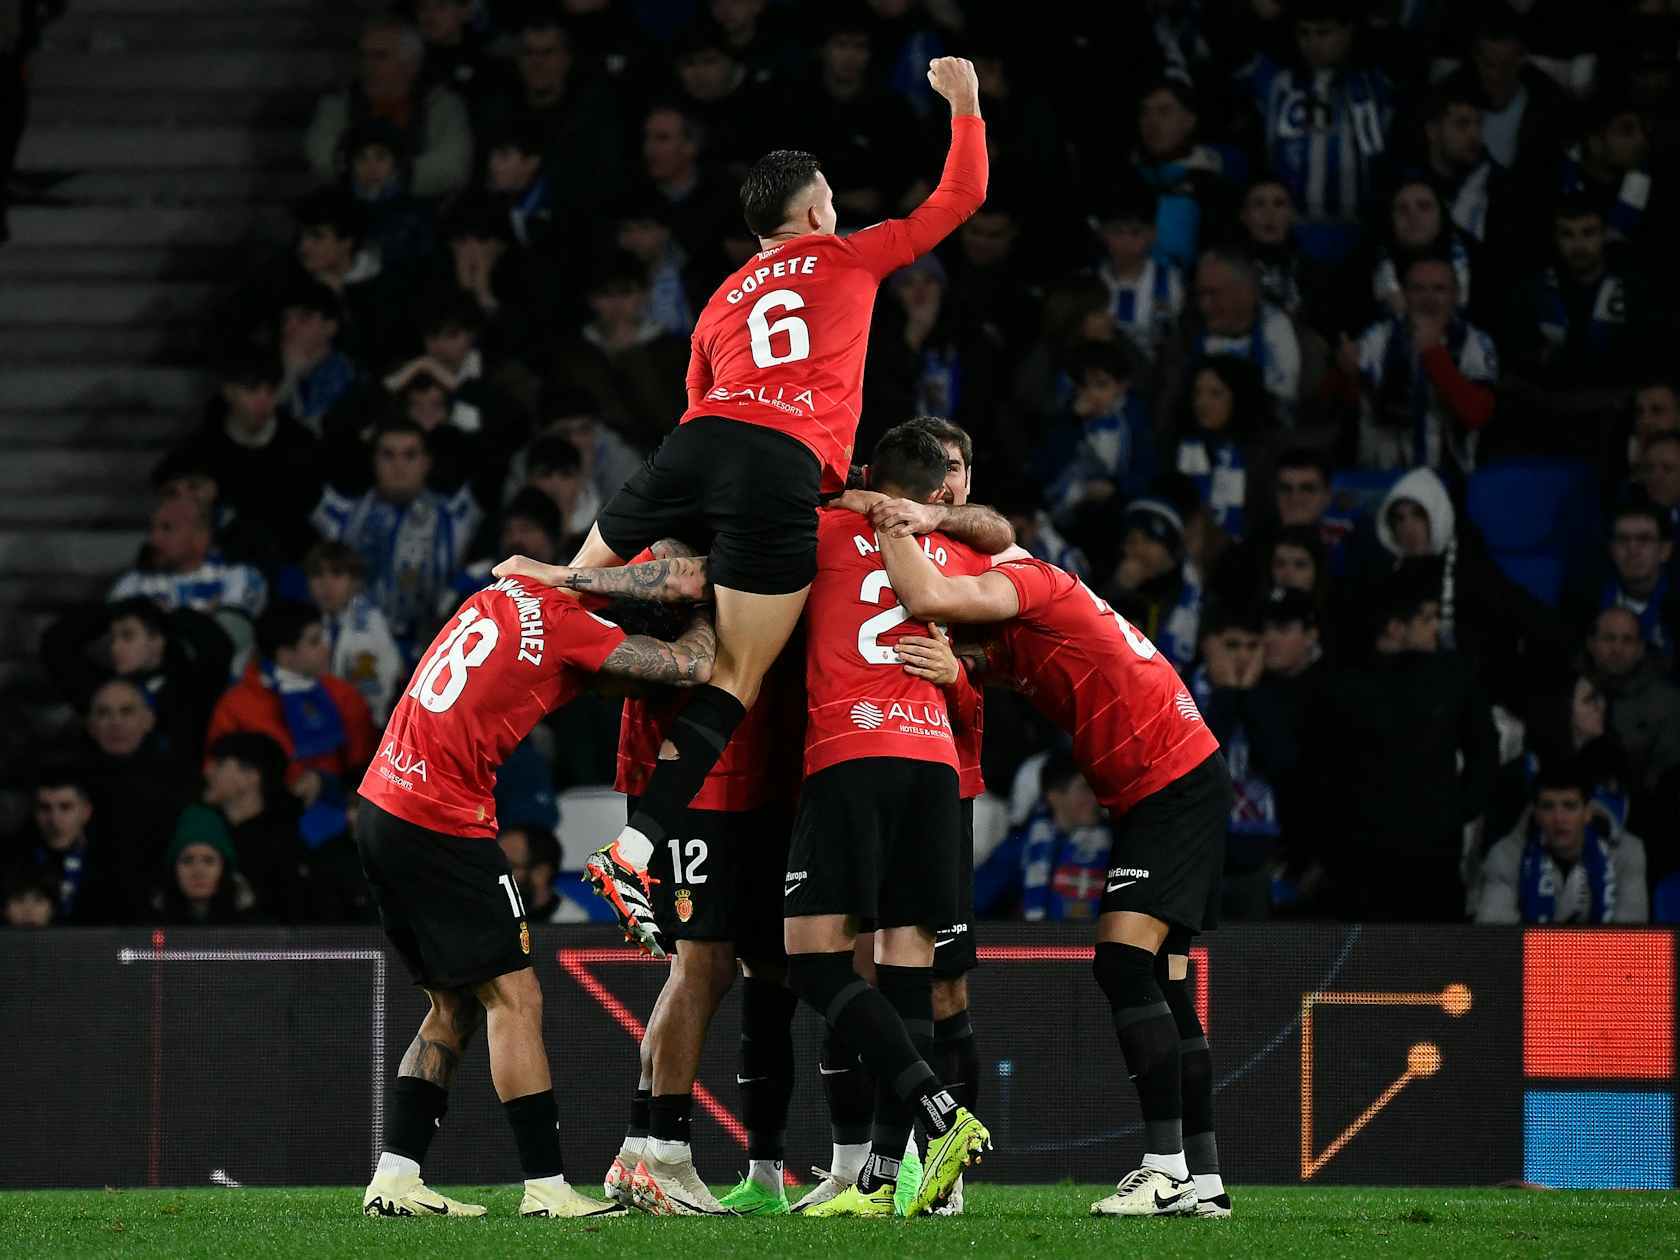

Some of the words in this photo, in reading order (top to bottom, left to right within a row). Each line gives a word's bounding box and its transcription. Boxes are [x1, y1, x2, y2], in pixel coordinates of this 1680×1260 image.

[725, 255, 818, 305] COPETE
[746, 288, 811, 369] 6
[858, 569, 917, 665] 2
[408, 606, 500, 714] 18
[668, 838, 708, 884] 12
[498, 873, 526, 918] 1
